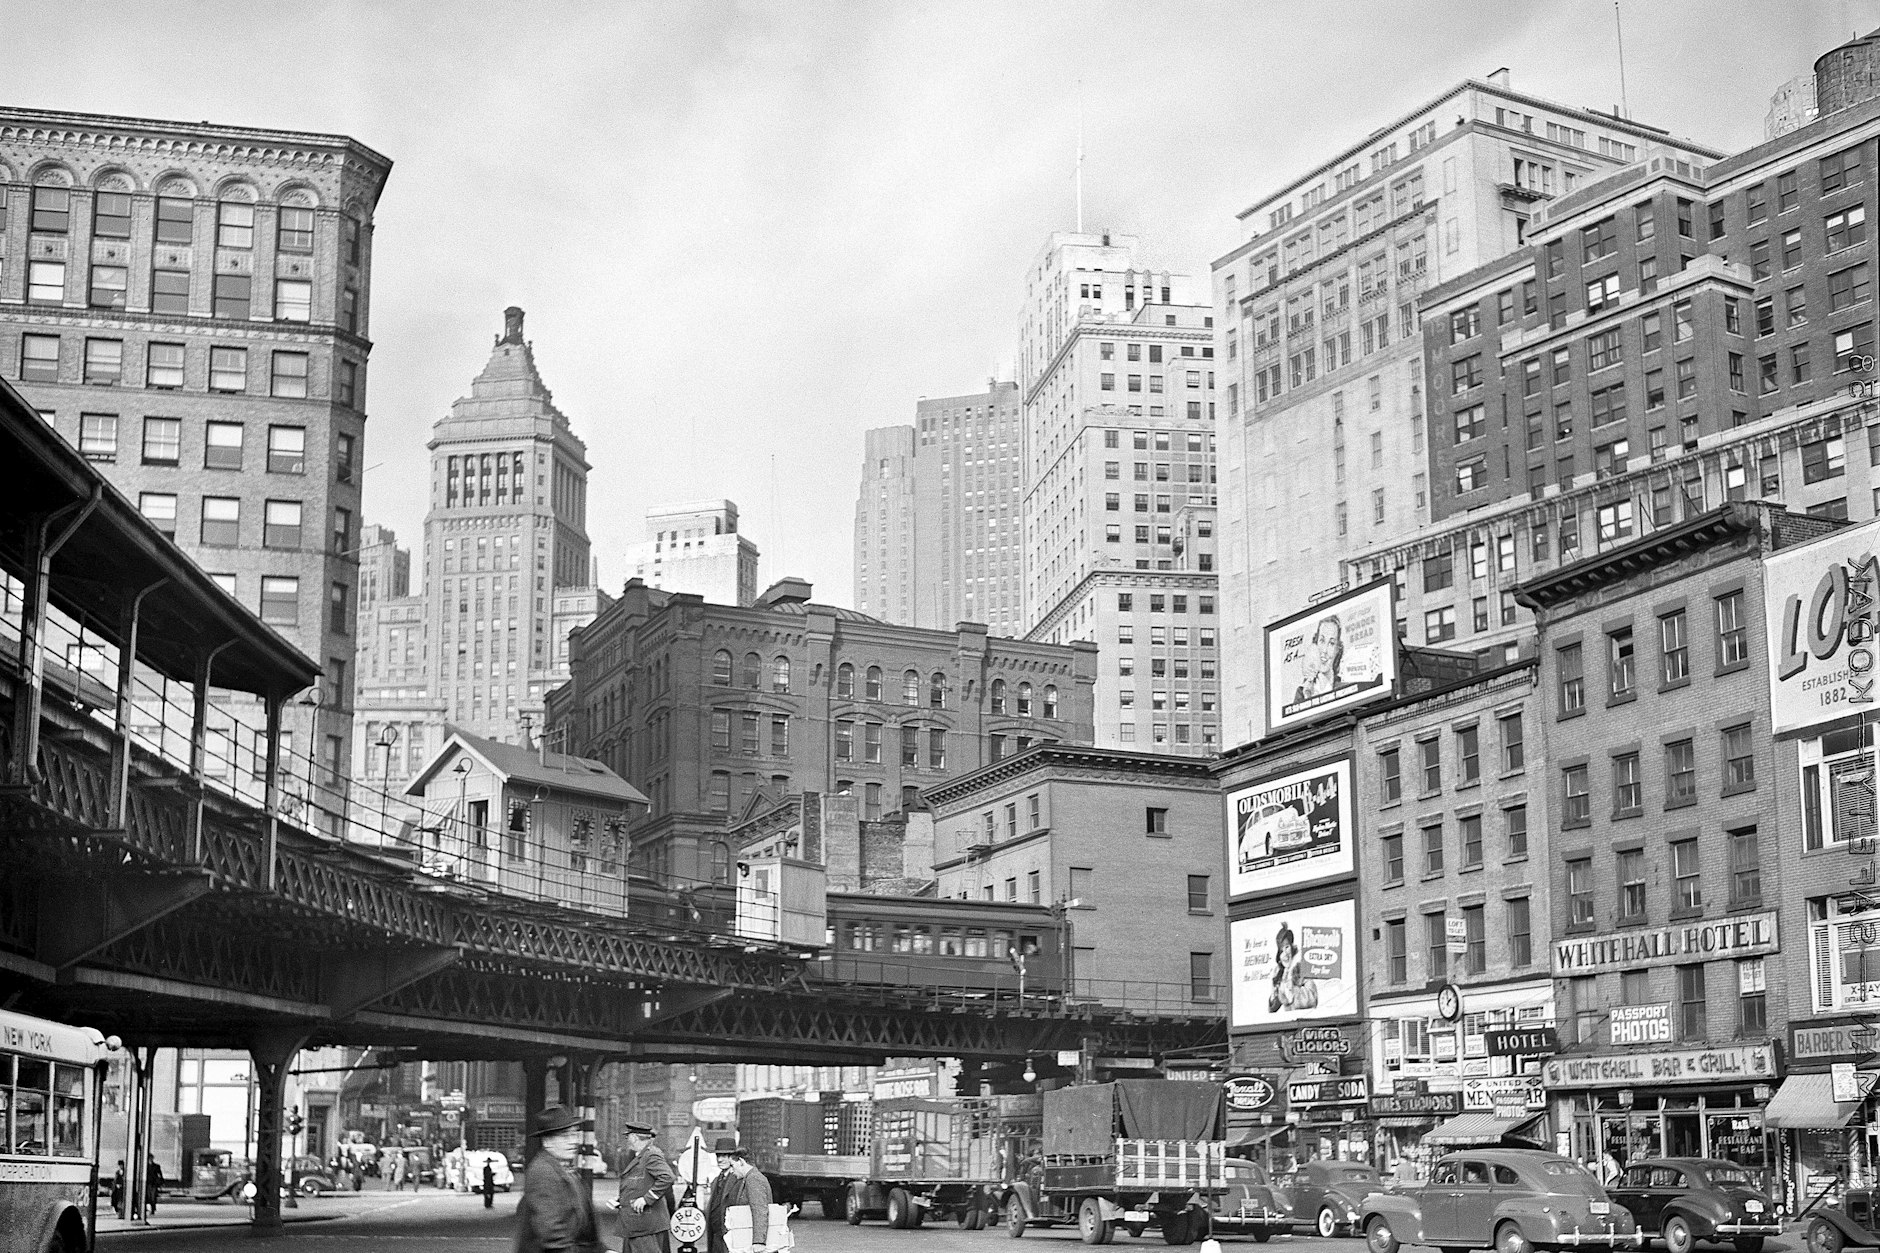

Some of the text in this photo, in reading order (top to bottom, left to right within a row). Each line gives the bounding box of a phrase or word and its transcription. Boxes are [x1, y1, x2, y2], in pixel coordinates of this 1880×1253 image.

[1820, 687, 1848, 706] 1882
[1239, 781, 1311, 814] OLDSMOBILE
[1557, 919, 1771, 969] WHITEHALL HOTEL
[1611, 1005, 1668, 1020] PASSPORT
[4, 1026, 52, 1052] NEW YORK
[1305, 1030, 1338, 1040] WINES
[1611, 1019, 1670, 1042] PHOTOS
[1296, 1040, 1349, 1052] LIQUORS
[1497, 1033, 1552, 1051] HOTEL
[1797, 1030, 1844, 1054] BARBER
[1568, 1058, 1643, 1081] WHITEHALL
[1651, 1055, 1682, 1077] BAR
[1700, 1051, 1741, 1074] GRILL
[1166, 1069, 1208, 1081] UNITED
[1290, 1084, 1321, 1101] CANDY
[1337, 1081, 1366, 1098] SODA
[1372, 1097, 1401, 1112] WINES
[1409, 1095, 1454, 1111] LIQUORS
[1496, 1105, 1526, 1118] PHOTOS
[1718, 1136, 1762, 1145] RESTAURANT
[1782, 1144, 1791, 1182] STEAKS
[1785, 1180, 1795, 1214] CHOPS
[675, 1210, 702, 1221] BUS
[673, 1226, 701, 1237] STOP
